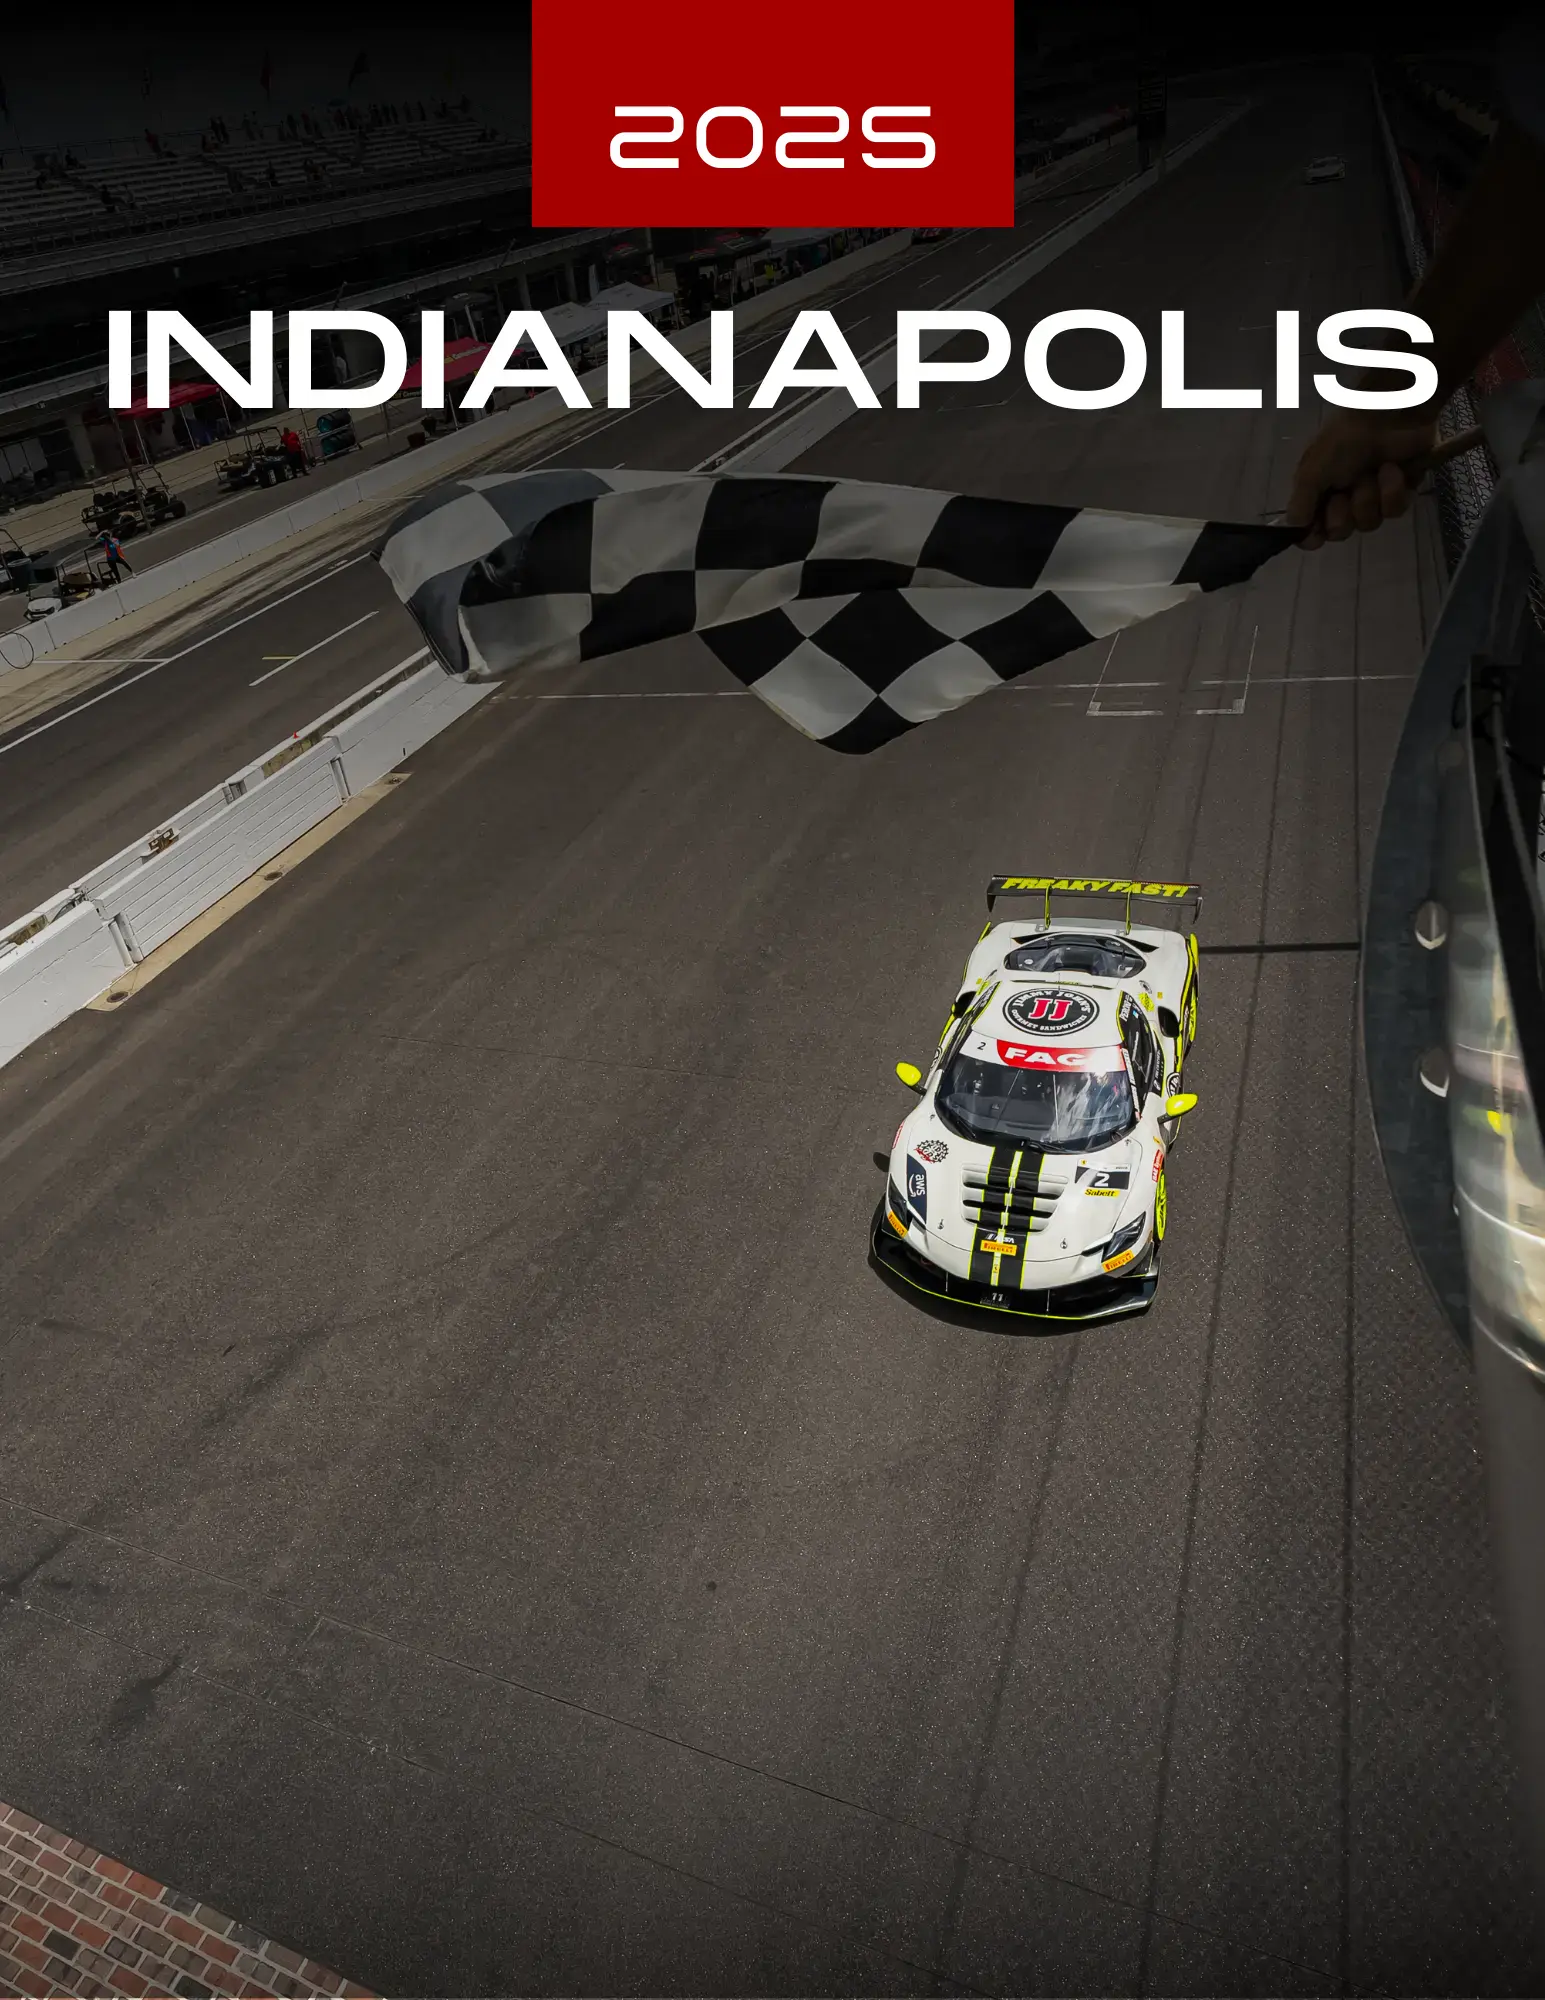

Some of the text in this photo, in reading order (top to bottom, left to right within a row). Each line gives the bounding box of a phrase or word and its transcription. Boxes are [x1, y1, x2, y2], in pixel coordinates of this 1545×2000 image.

[1001, 877, 1190, 898] FREAKY FAST!
[1012, 990, 1053, 1007] JIMMY
[1056, 990, 1091, 1013] JOHN'S
[1028, 998, 1073, 1021] JJ
[1011, 1009, 1088, 1031] GOURMET SANDWICHES
[977, 1041, 986, 1050] 2
[915, 1174, 925, 1196] aws
[1094, 1172, 1110, 1187] 2
[983, 1242, 1014, 1253] PIRELLI
[1105, 1252, 1132, 1270] PIRELLI
